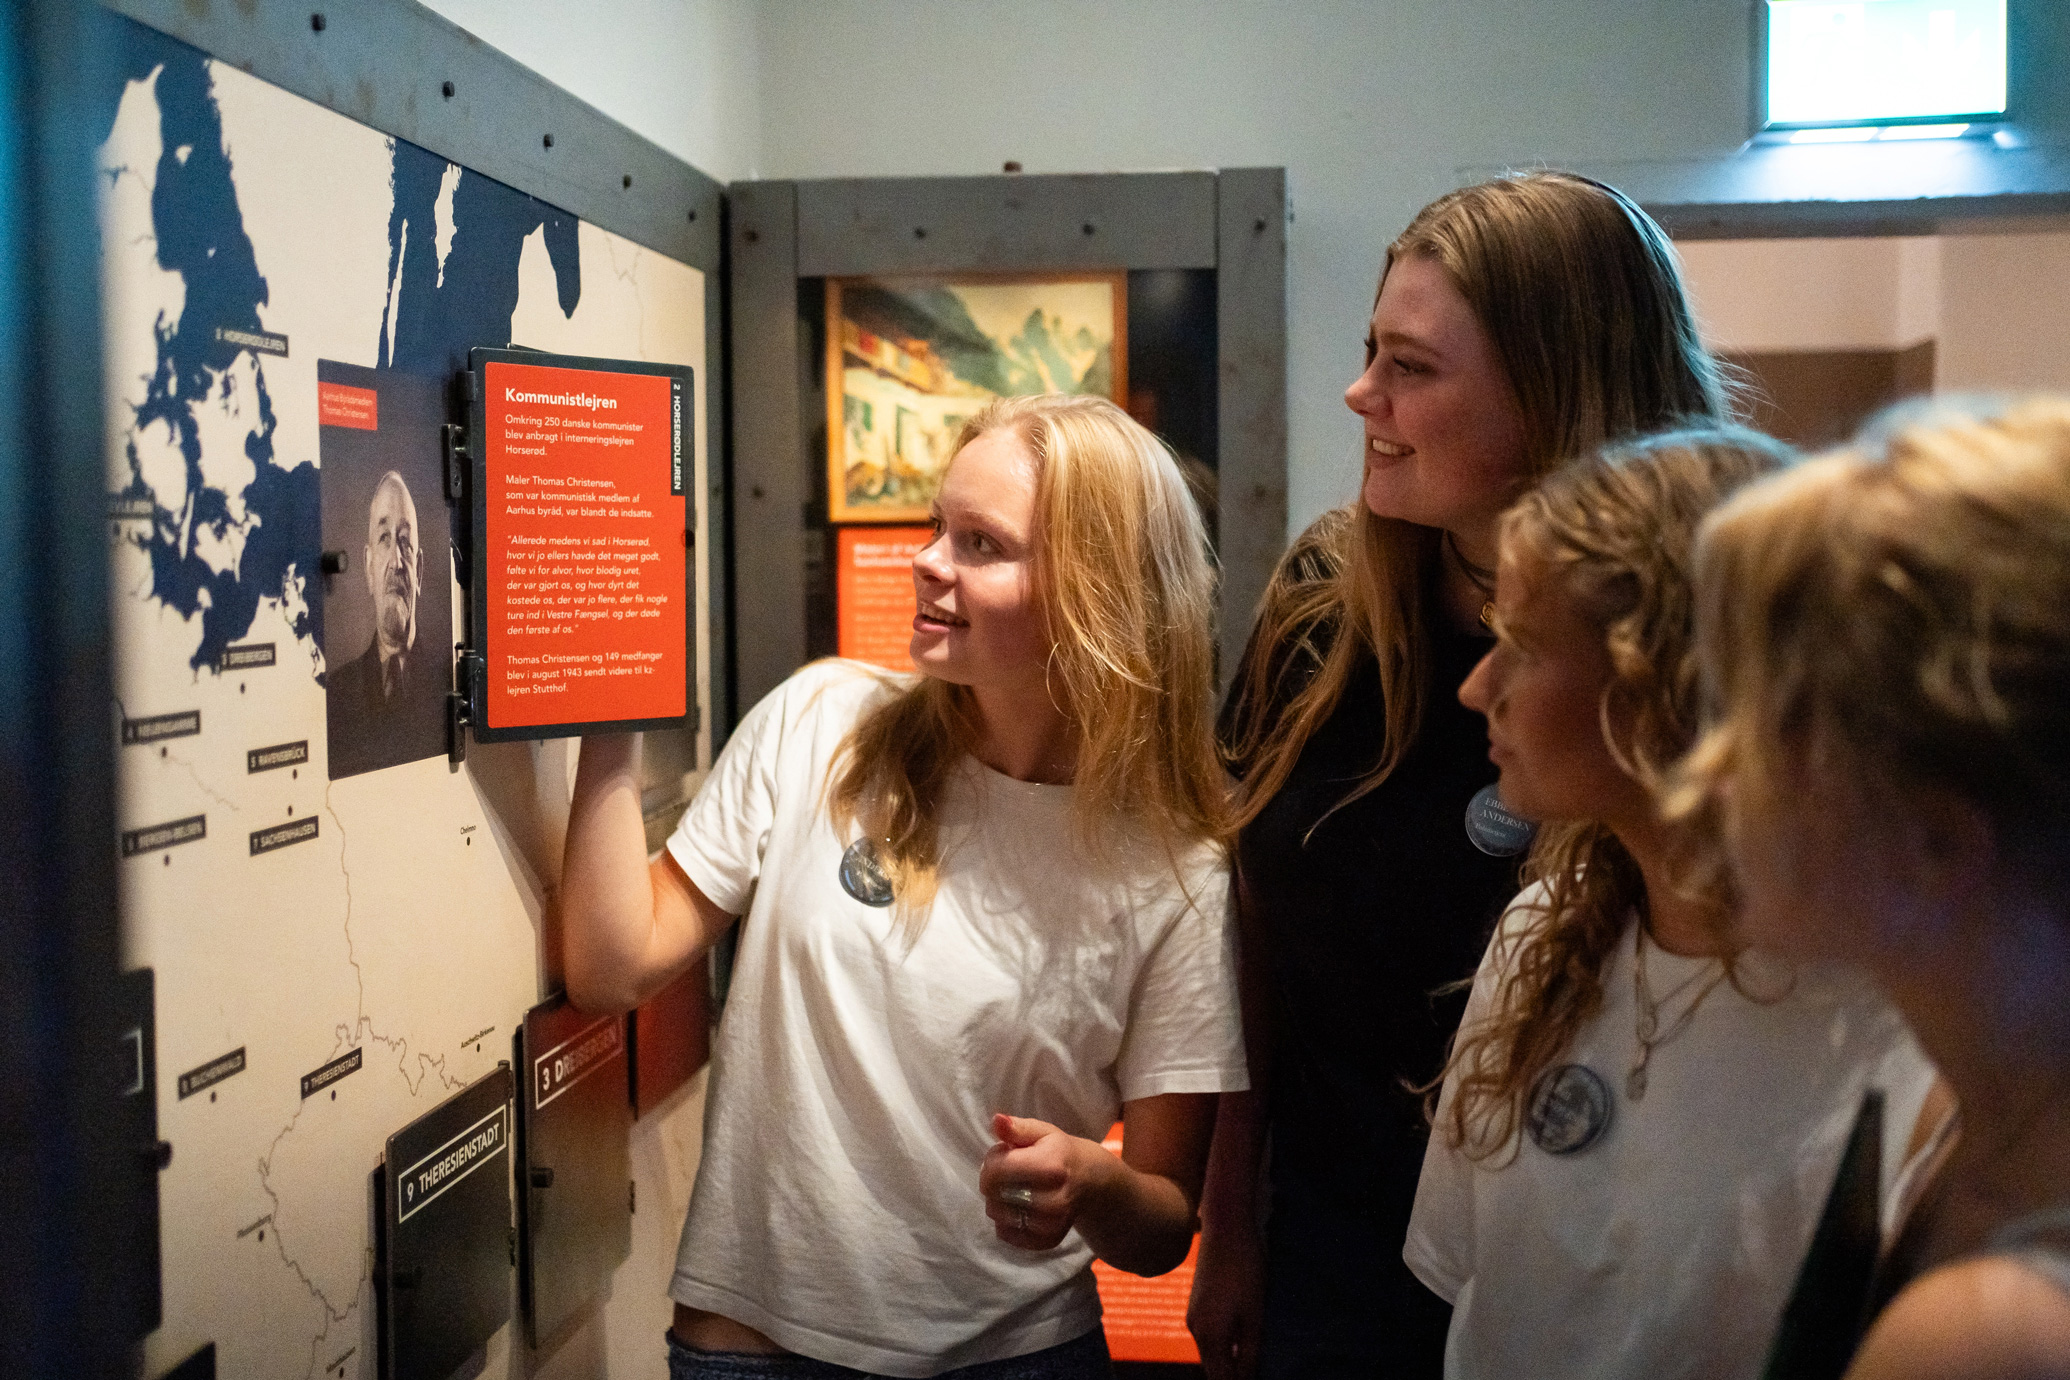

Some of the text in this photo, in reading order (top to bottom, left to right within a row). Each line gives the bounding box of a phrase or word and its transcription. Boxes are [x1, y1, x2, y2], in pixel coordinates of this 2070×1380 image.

[506, 387, 617, 411] Kommunistlejren
[505, 414, 643, 431] Omkring 250 danske kommunister
[505, 429, 523, 439] blev
[526, 431, 558, 443] anbragt
[565, 433, 634, 447] interneringslejren
[673, 383, 681, 490] 2 HORSERØDLEJREN
[506, 445, 547, 455] Horserød.
[506, 475, 616, 489] Maler Thomas Christensen,
[541, 490, 596, 501] kommunistisk
[599, 493, 630, 502] medlem
[632, 494, 640, 503] af
[506, 505, 535, 515] Aarhus
[538, 505, 563, 517] byråd,
[581, 507, 606, 516] blandt
[608, 507, 619, 517] de
[621, 508, 654, 518] indsatte.
[549, 536, 581, 545] medens
[583, 537, 590, 545] vi
[592, 537, 606, 545] sad
[507, 550, 660, 563] hvor vi jo ellers havde det meget godt,
[507, 565, 526, 574] følte
[529, 566, 536, 574] vi
[538, 565, 550, 574] for
[552, 565, 573, 575] alvor,
[576, 565, 594, 574] hvor
[596, 565, 621, 577] blodig
[507, 580, 521, 589] der
[539, 581, 558, 592] gjort
[575, 583, 586, 592] og
[588, 580, 606, 589] hvor
[608, 580, 624, 591] dyrt
[626, 580, 639, 589] det
[507, 595, 541, 604] kostede
[543, 597, 554, 605] os,
[557, 595, 571, 604] der
[587, 595, 595, 606] jo
[598, 594, 617, 604] flere,
[620, 594, 633, 603] der
[635, 594, 644, 603] fik
[646, 594, 668, 605] nogle
[507, 612, 524, 620] ture
[527, 610, 540, 619] ind
[547, 610, 572, 619] Vestre
[575, 609, 610, 621] Fængsel,
[612, 611, 623, 620] og
[625, 609, 638, 618] der
[640, 608, 660, 617] døde
[507, 625, 523, 635] den
[526, 625, 550, 634] første
[552, 624, 561, 633] af
[507, 651, 663, 664] Thomas Christensen og 149 medfanger
[507, 670, 525, 680] blev
[532, 670, 559, 681] august
[563, 668, 582, 677] 1943
[584, 667, 606, 676] sendt
[608, 666, 633, 675] videre
[634, 665, 642, 674] til
[644, 666, 655, 674] kz-
[507, 682, 568, 697] lejren Stutthof.
[542, 1067, 550, 1091] 3
[407, 1122, 500, 1202] 9 THERESIENSTADT
